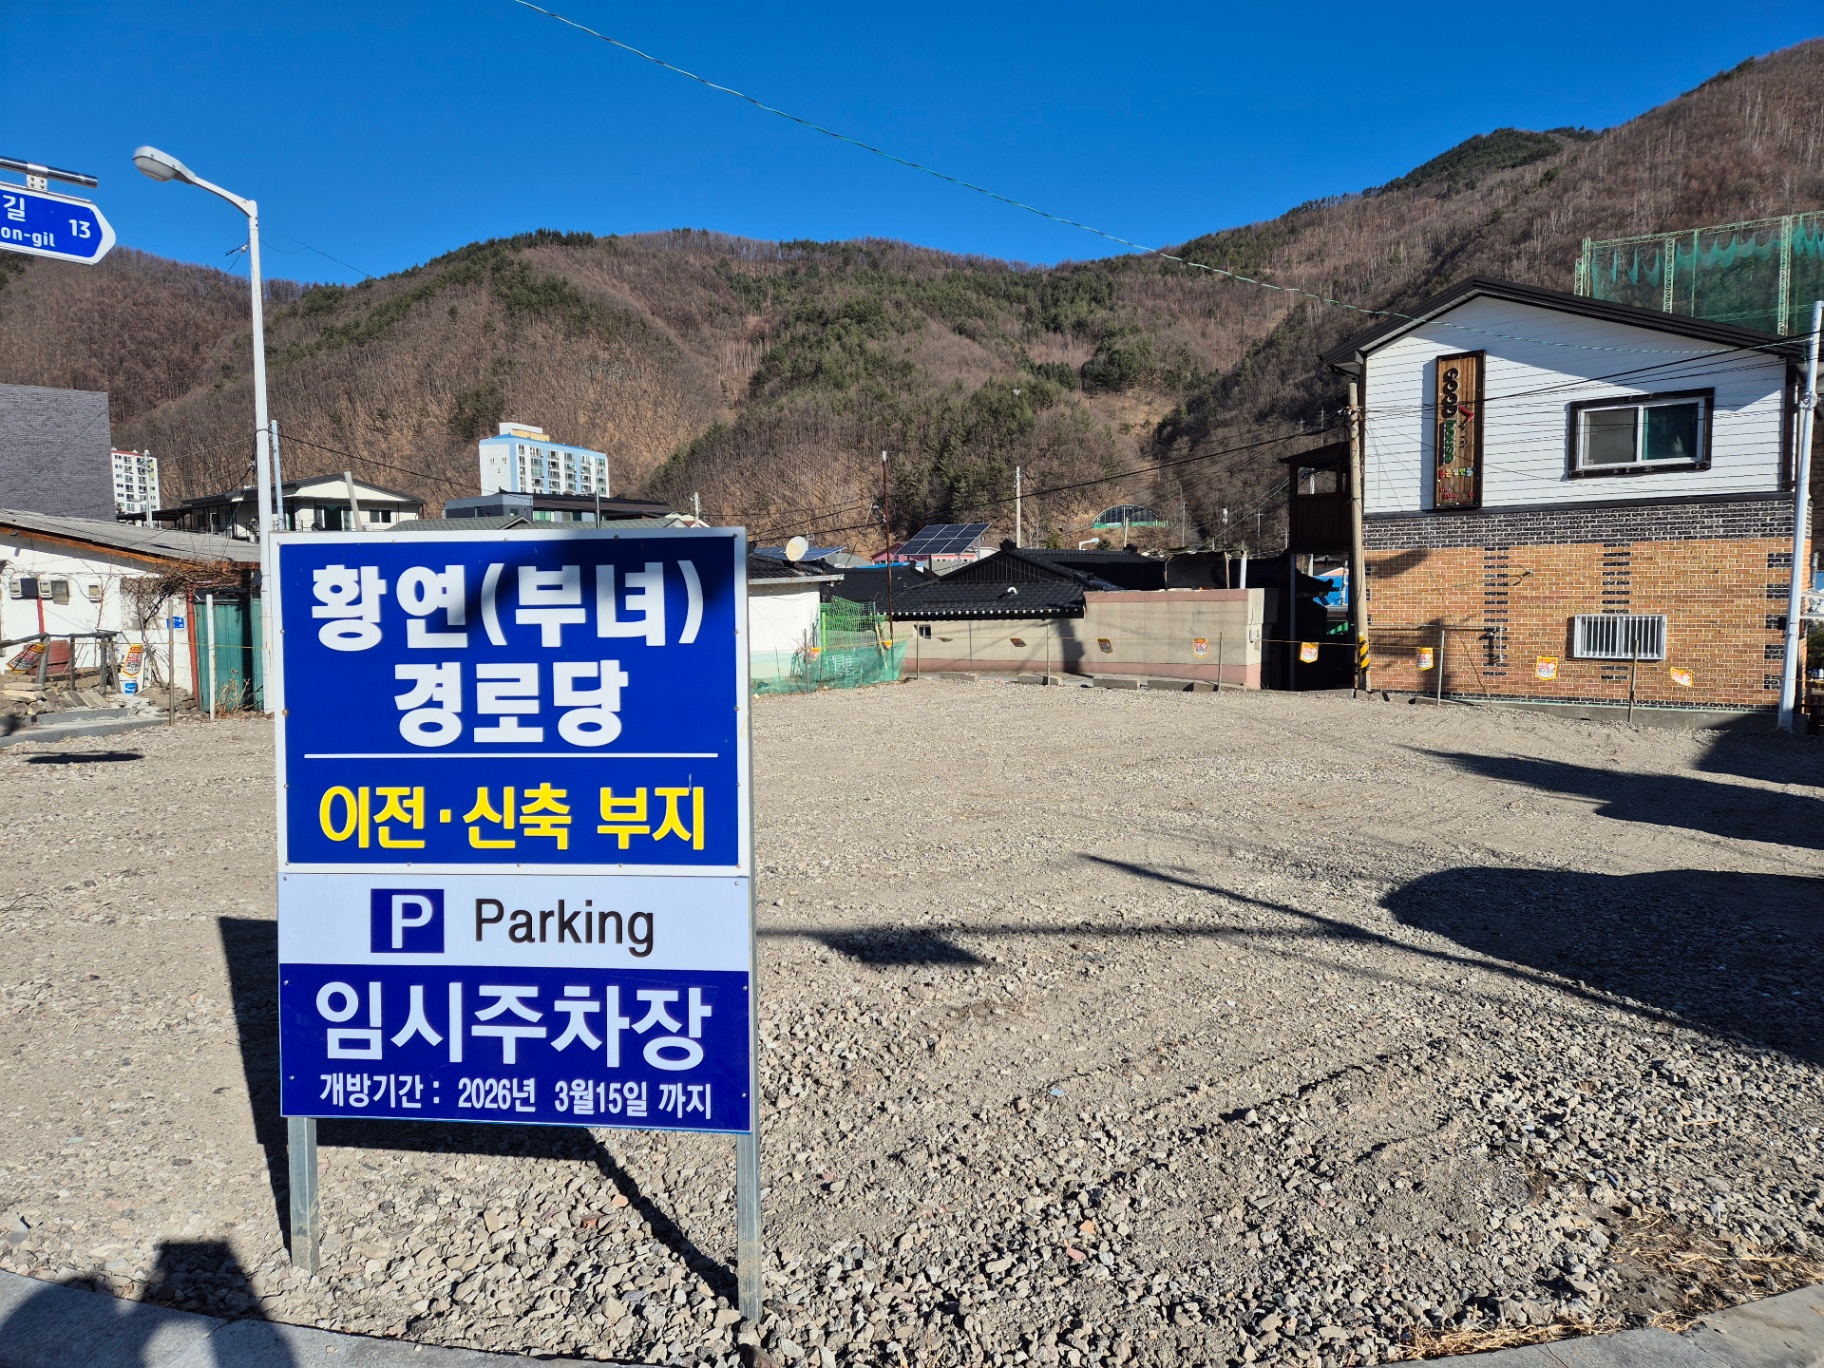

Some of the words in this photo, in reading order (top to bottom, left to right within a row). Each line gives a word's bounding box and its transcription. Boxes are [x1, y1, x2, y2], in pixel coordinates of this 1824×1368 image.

[68, 219, 91, 239] 13
[1443, 367, 1459, 419] GOOD
[312, 560, 704, 652] 황연(부녀)
[394, 659, 629, 748] 경로당
[597, 786, 705, 851] 부지
[391, 894, 434, 949] P
[475, 898, 655, 958] Parking
[316, 981, 713, 1071] 임시주차장
[458, 1078, 536, 1113] 2026년
[555, 1078, 648, 1118] 3월15일
[659, 1083, 712, 1120] 까지
